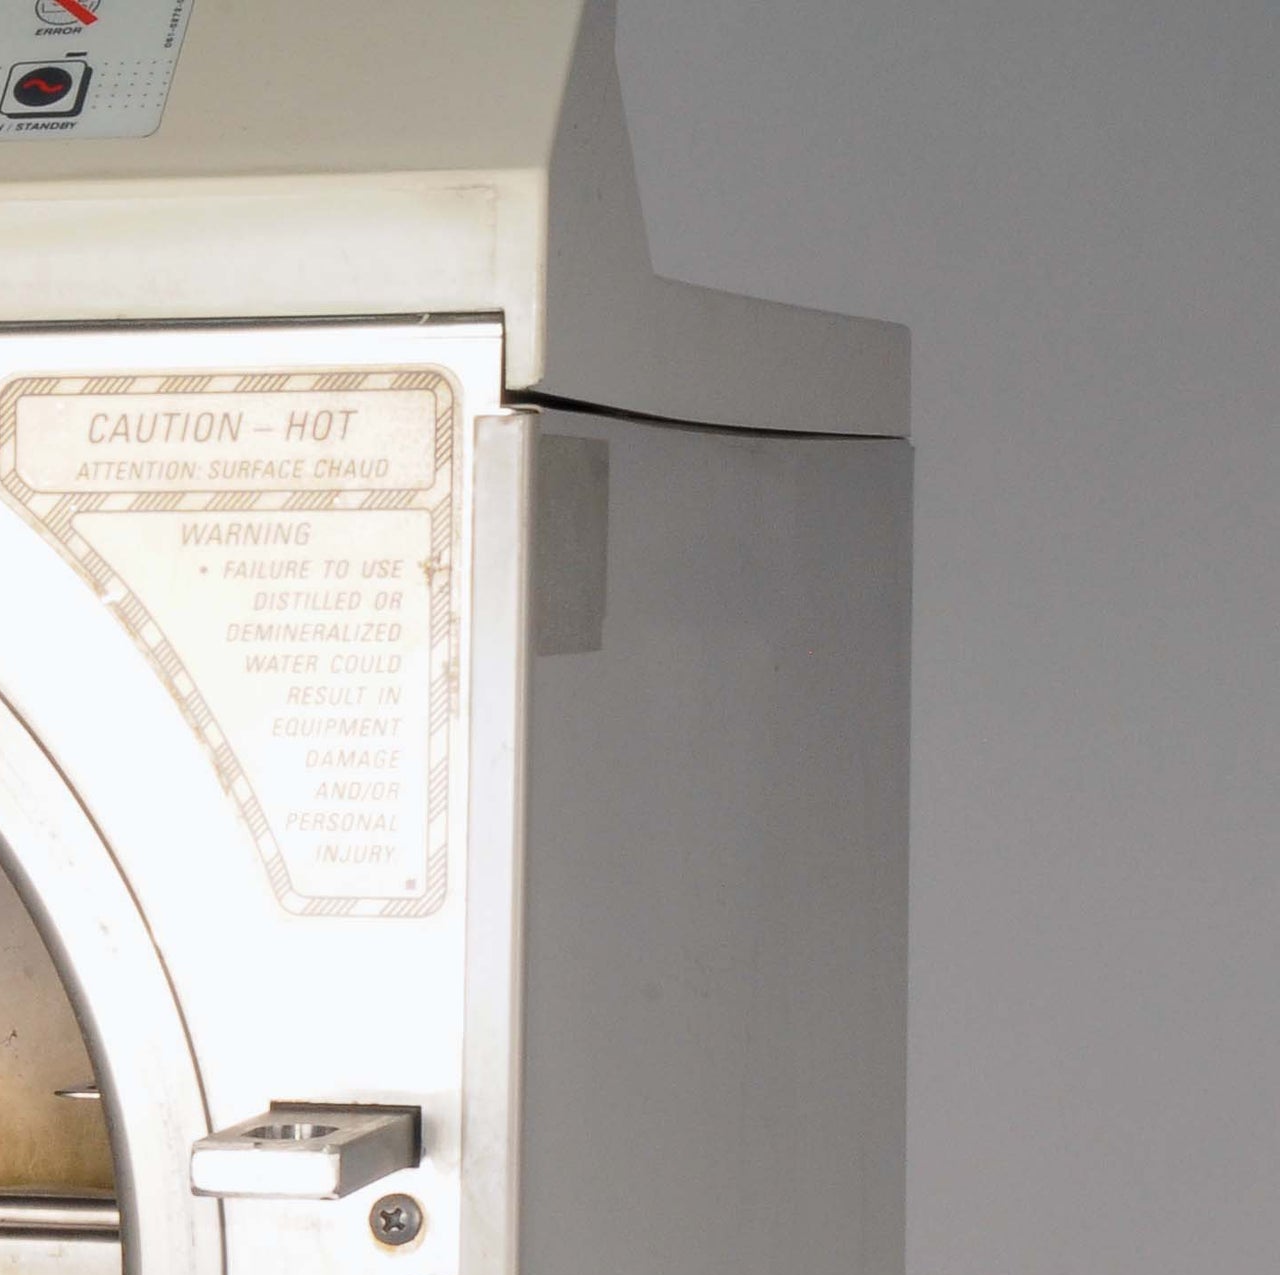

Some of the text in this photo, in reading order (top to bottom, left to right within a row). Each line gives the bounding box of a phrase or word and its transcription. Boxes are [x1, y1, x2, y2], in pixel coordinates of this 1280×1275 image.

[35, 27, 84, 37] ERROR
[15, 122, 78, 131] STANDBY
[87, 410, 358, 444] CAUTION HOT
[75, 458, 390, 482] ATTENTION: SURFACE CHAUD
[180, 522, 312, 547] WARNING
[222, 560, 404, 580] FAILURE TO USE
[252, 592, 404, 611] DISTILLED OR
[226, 623, 402, 643] DEMINERALIZED
[245, 655, 402, 674] WATER COULD
[286, 686, 402, 706] RESULT IN
[272, 718, 402, 738] EQUIPMENT
[304, 750, 400, 770] DAMAGE
[314, 782, 400, 801] AND/OR
[285, 813, 399, 832] PERSONAL
[314, 844, 396, 864] INJURY
